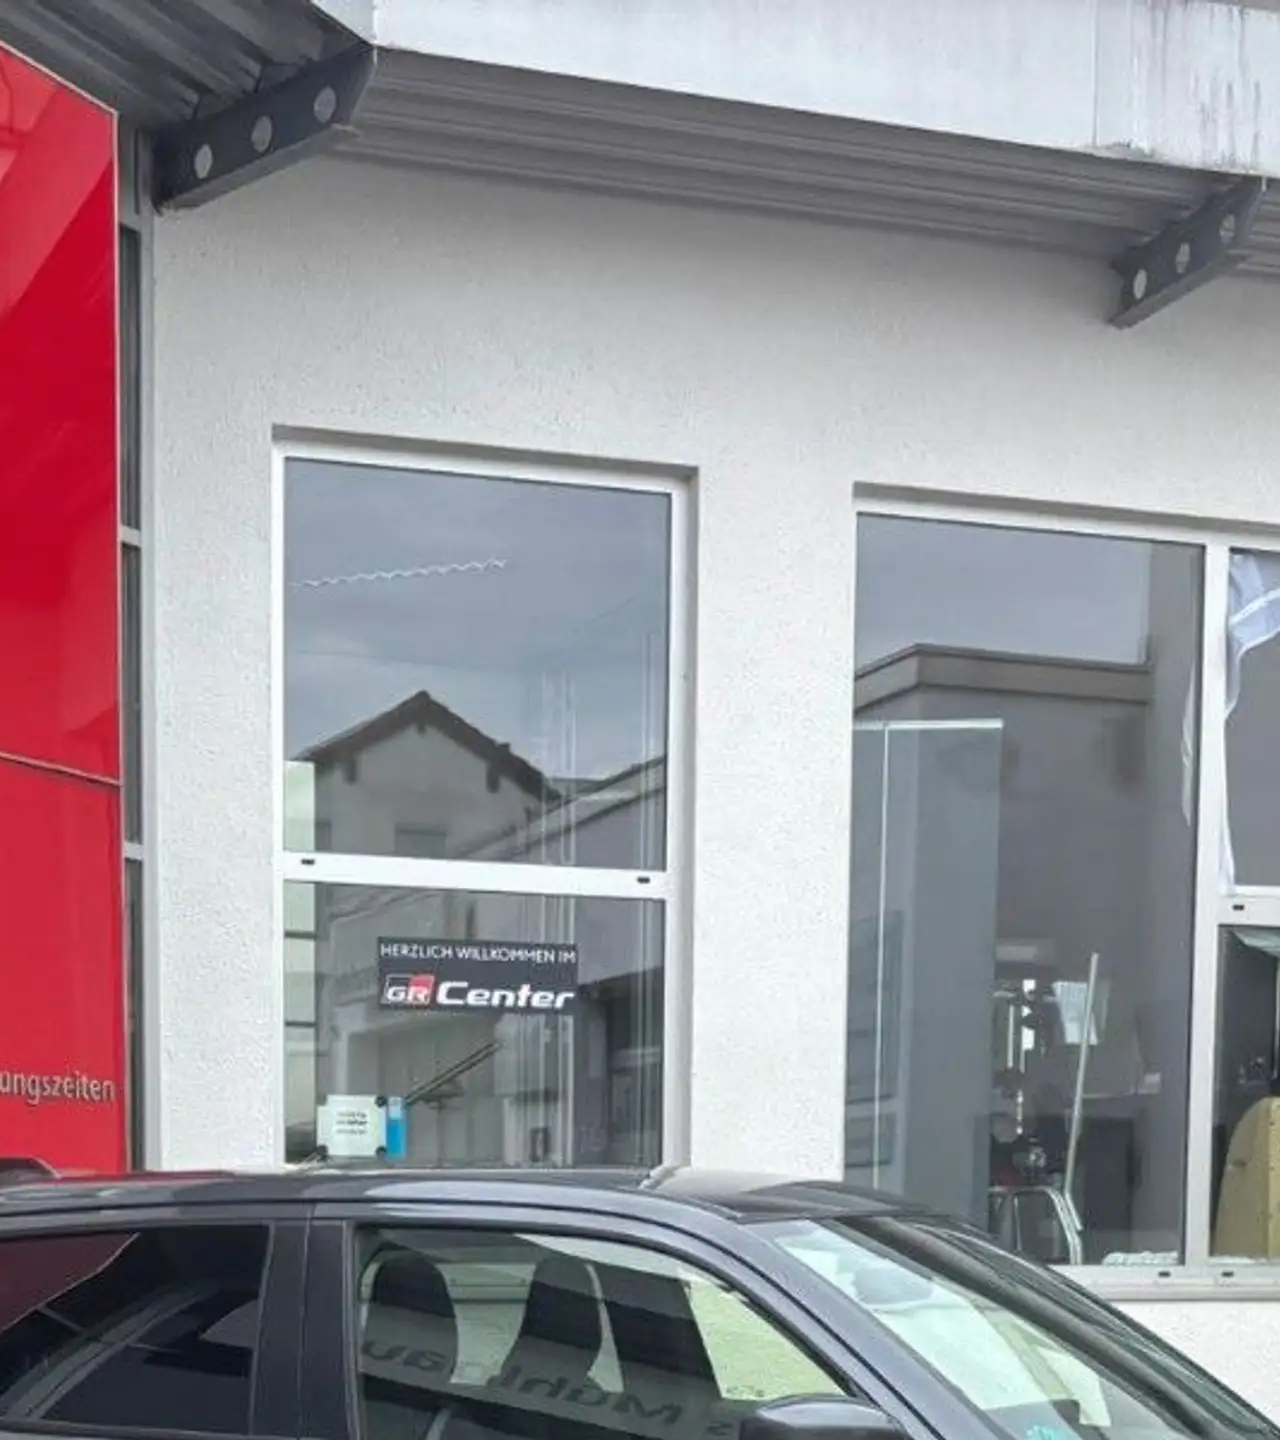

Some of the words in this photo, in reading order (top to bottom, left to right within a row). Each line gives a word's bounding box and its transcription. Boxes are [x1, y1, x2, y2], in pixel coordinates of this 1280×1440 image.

[380, 943, 453, 960] HERZLICH
[455, 946, 556, 964] WILLKOMMEN
[558, 950, 576, 964] IM
[435, 980, 576, 1010] Center
